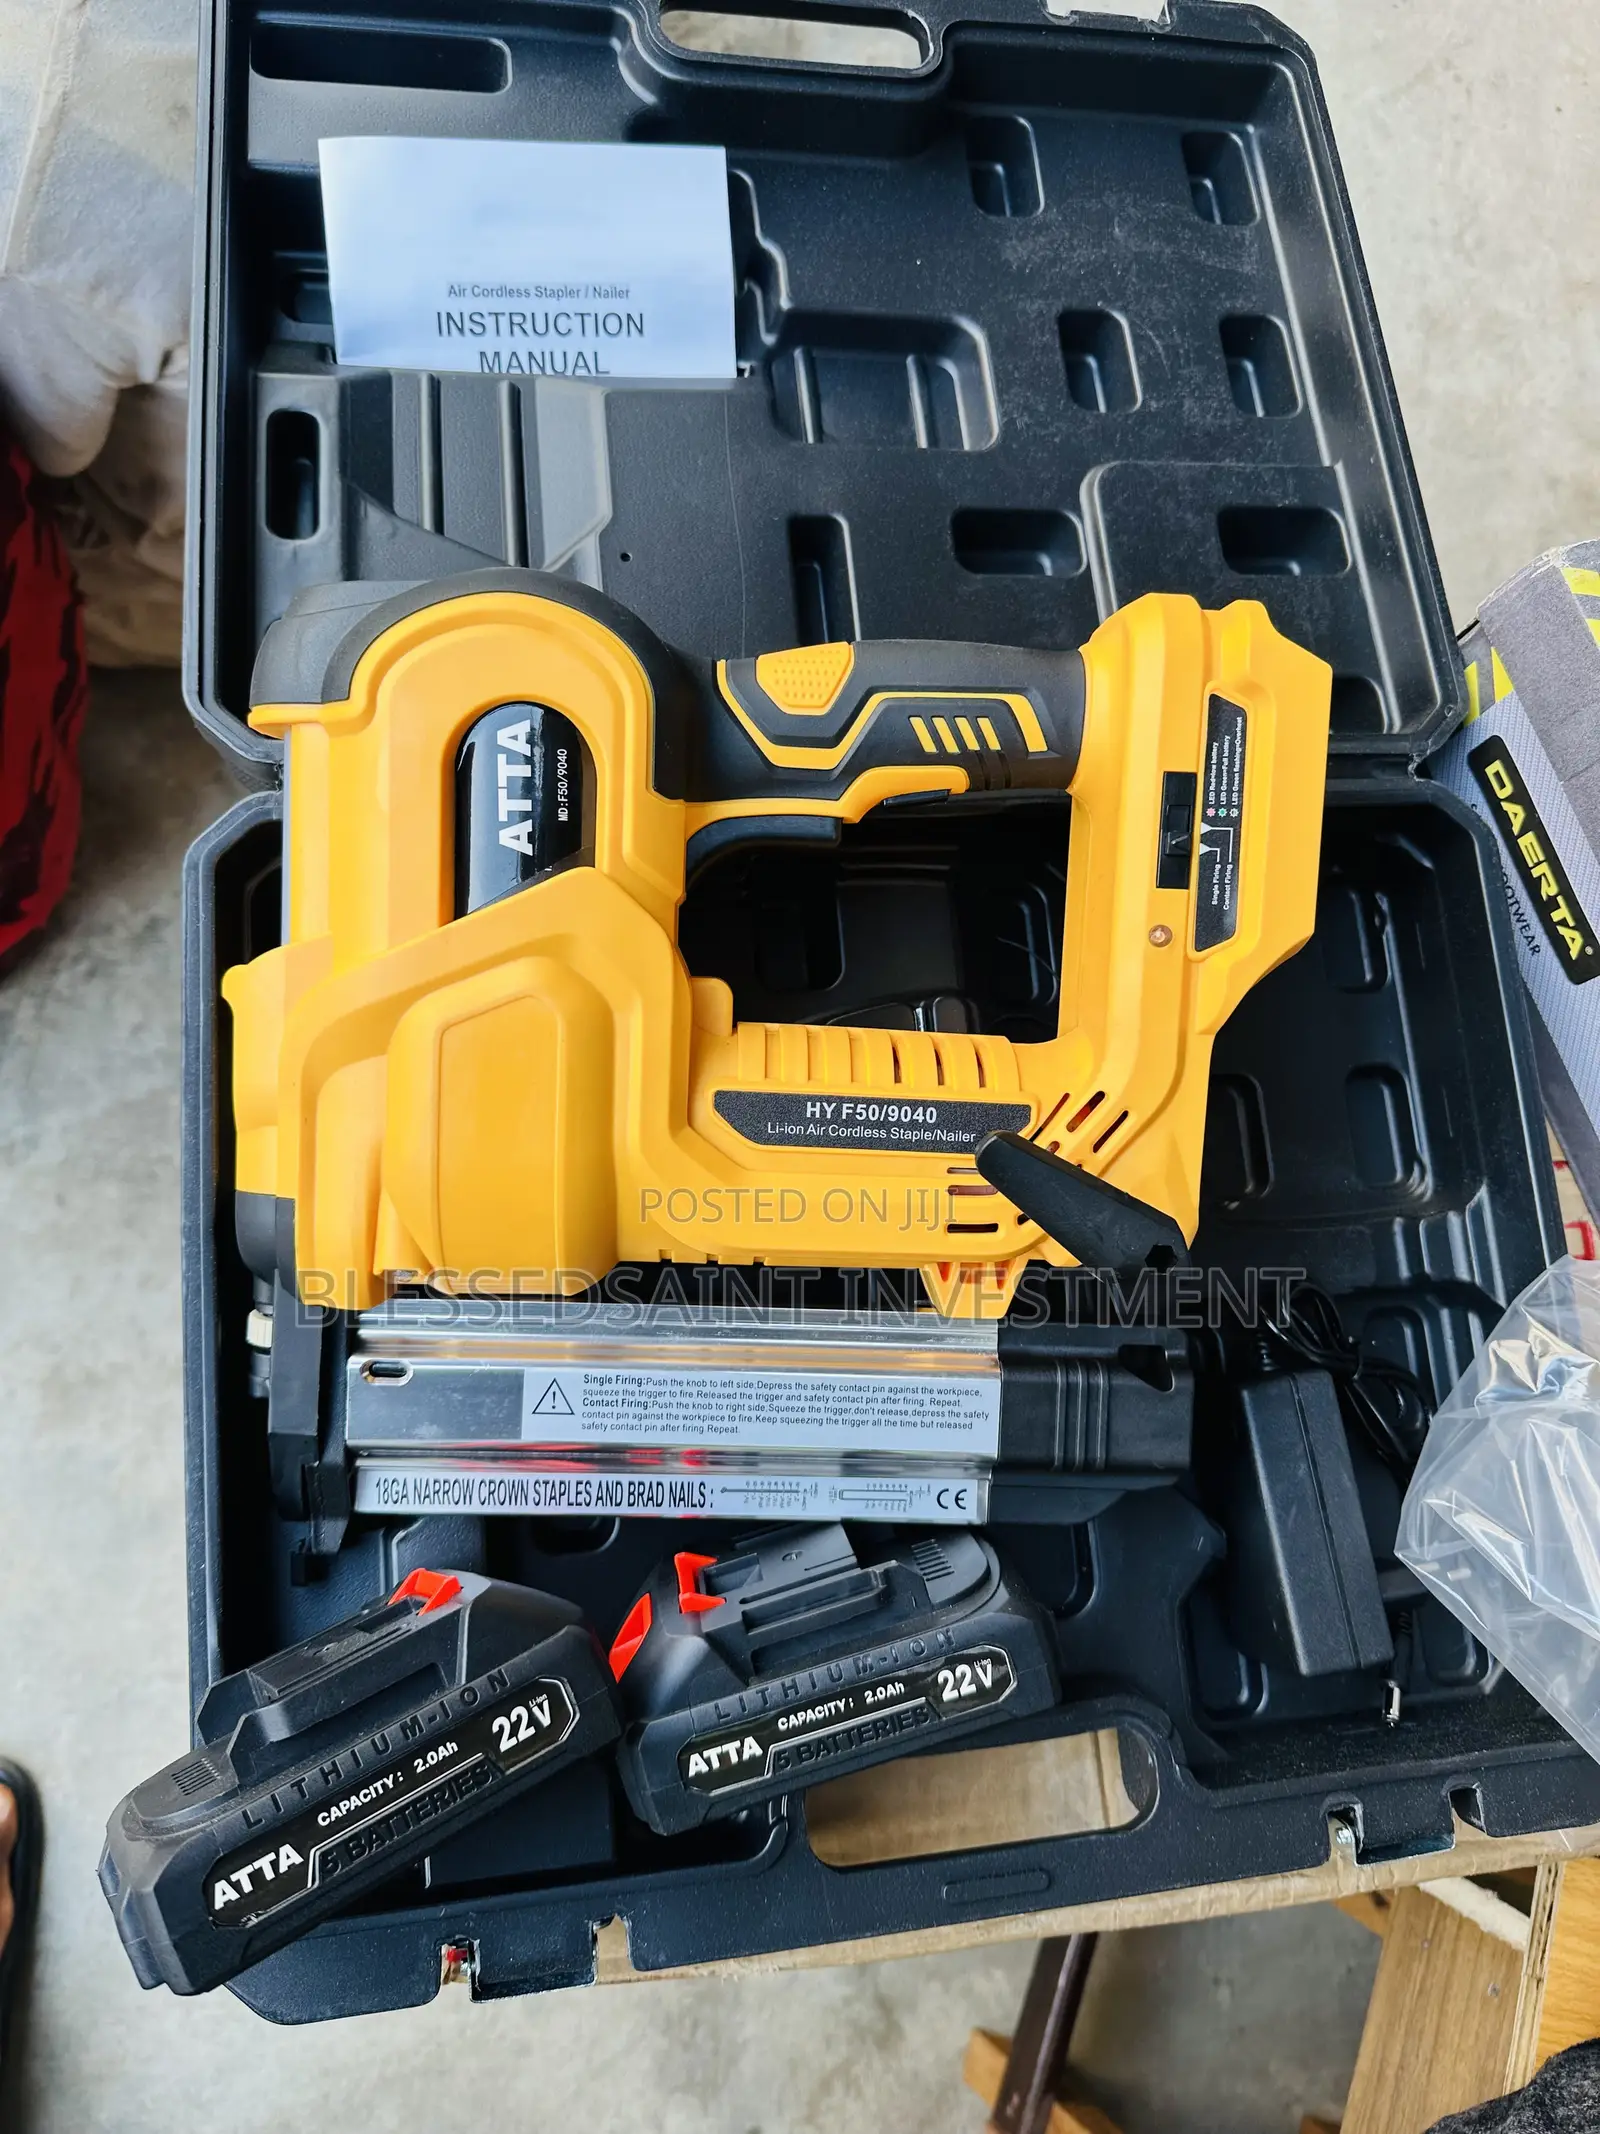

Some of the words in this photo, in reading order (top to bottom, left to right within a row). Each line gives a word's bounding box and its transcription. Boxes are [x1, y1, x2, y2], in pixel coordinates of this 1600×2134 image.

[448, 285, 467, 298] Air
[471, 284, 531, 299] Cordless
[534, 285, 581, 301] Stapler
[584, 286, 589, 299] /
[593, 286, 630, 300] Nailer
[436, 311, 645, 338] INSTRUCTION
[479, 350, 611, 375] MANUAL
[1210, 742, 1219, 764] battery
[1222, 735, 1231, 757] battery
[496, 719, 534, 857] ATTA
[557, 748, 569, 822] MD:F50/9040
[1232, 772, 1240, 791] Green
[1212, 864, 1221, 884] Firing
[1225, 864, 1233, 884] Firing
[1211, 884, 1220, 905] Single
[1223, 884, 1231, 910] Contact
[806, 1101, 837, 1119] HY
[842, 1103, 938, 1124] F50/9040
[767, 1122, 804, 1135] Li-ion
[807, 1123, 825, 1136] Air
[828, 1124, 887, 1139] Cordless
[890, 1128, 976, 1143] Staple/Nailer
[583, 1374, 613, 1387] Single
[670, 1379, 684, 1387] the
[686, 1380, 707, 1388] knob
[709, 1380, 718, 1388] to
[720, 1380, 734, 1389] left
[795, 1382, 808, 1391] the
[810, 1382, 836, 1393] safety
[838, 1383, 870, 1393] contact
[872, 1384, 885, 1394] pin
[887, 1385, 919, 1396] against
[921, 1386, 935, 1395] the
[936, 1387, 983, 1398] workpiece,
[583, 1388, 620, 1398] squeeze
[622, 1388, 636, 1397] the
[638, 1389, 667, 1399] trigger
[669, 1390, 677, 1398] to
[739, 1391, 753, 1400] the
[755, 1392, 784, 1402] trigger
[785, 1393, 801, 1401] and
[803, 1394, 830, 1404] safety
[832, 1395, 864, 1404] contact
[865, 1396, 879, 1405] pin
[880, 1396, 900, 1405] after
[581, 1410, 614, 1419] contact
[616, 1411, 630, 1421] pin
[631, 1412, 664, 1422] against
[666, 1412, 680, 1421] the
[681, 1413, 726, 1423] workpiece
[727, 1414, 736, 1422] to
[779, 1416, 824, 1427] squeezing
[825, 1416, 840, 1425] the
[841, 1417, 870, 1428] trigger
[871, 1418, 882, 1426] all
[884, 1418, 898, 1427] the
[899, 1419, 918, 1428] time
[920, 1420, 934, 1429] but
[936, 1421, 973, 1430] released
[582, 1397, 619, 1407] Contact
[676, 1401, 690, 1410] the
[692, 1402, 713, 1410] knob
[715, 1402, 724, 1411] to
[725, 1403, 746, 1413] right
[808, 1404, 822, 1413] the
[947, 1409, 961, 1418] the
[963, 1410, 990, 1421] safety
[581, 1421, 608, 1432] safety
[610, 1422, 642, 1431] contact
[644, 1423, 658, 1433] pin
[659, 1423, 680, 1432] after
[376, 1477, 410, 1505] 18GA
[413, 1477, 475, 1506] NARROW
[478, 1478, 529, 1507] CROWN
[532, 1479, 592, 1507] STAPLES
[595, 1480, 624, 1508] AND
[626, 1480, 664, 1508] BRAD
[936, 1488, 968, 1510] CE
[715, 1627, 957, 1724] LITHIUM-ION
[937, 1663, 992, 1703] 22V
[778, 1698, 854, 1732] CAPACITY:
[864, 1681, 905, 1704] 2.0Ah
[491, 1699, 552, 1753] 22V
[797, 1705, 930, 1762] BATTERIES
[242, 1667, 512, 1829] LITHIUM-ION
[687, 1736, 763, 1778] ATTA
[317, 1771, 404, 1827] CAPACITY:
[413, 1739, 459, 1774] 2.0Ah
[348, 1763, 494, 1861] BATTERIES
[213, 1843, 304, 1911] ATTA
